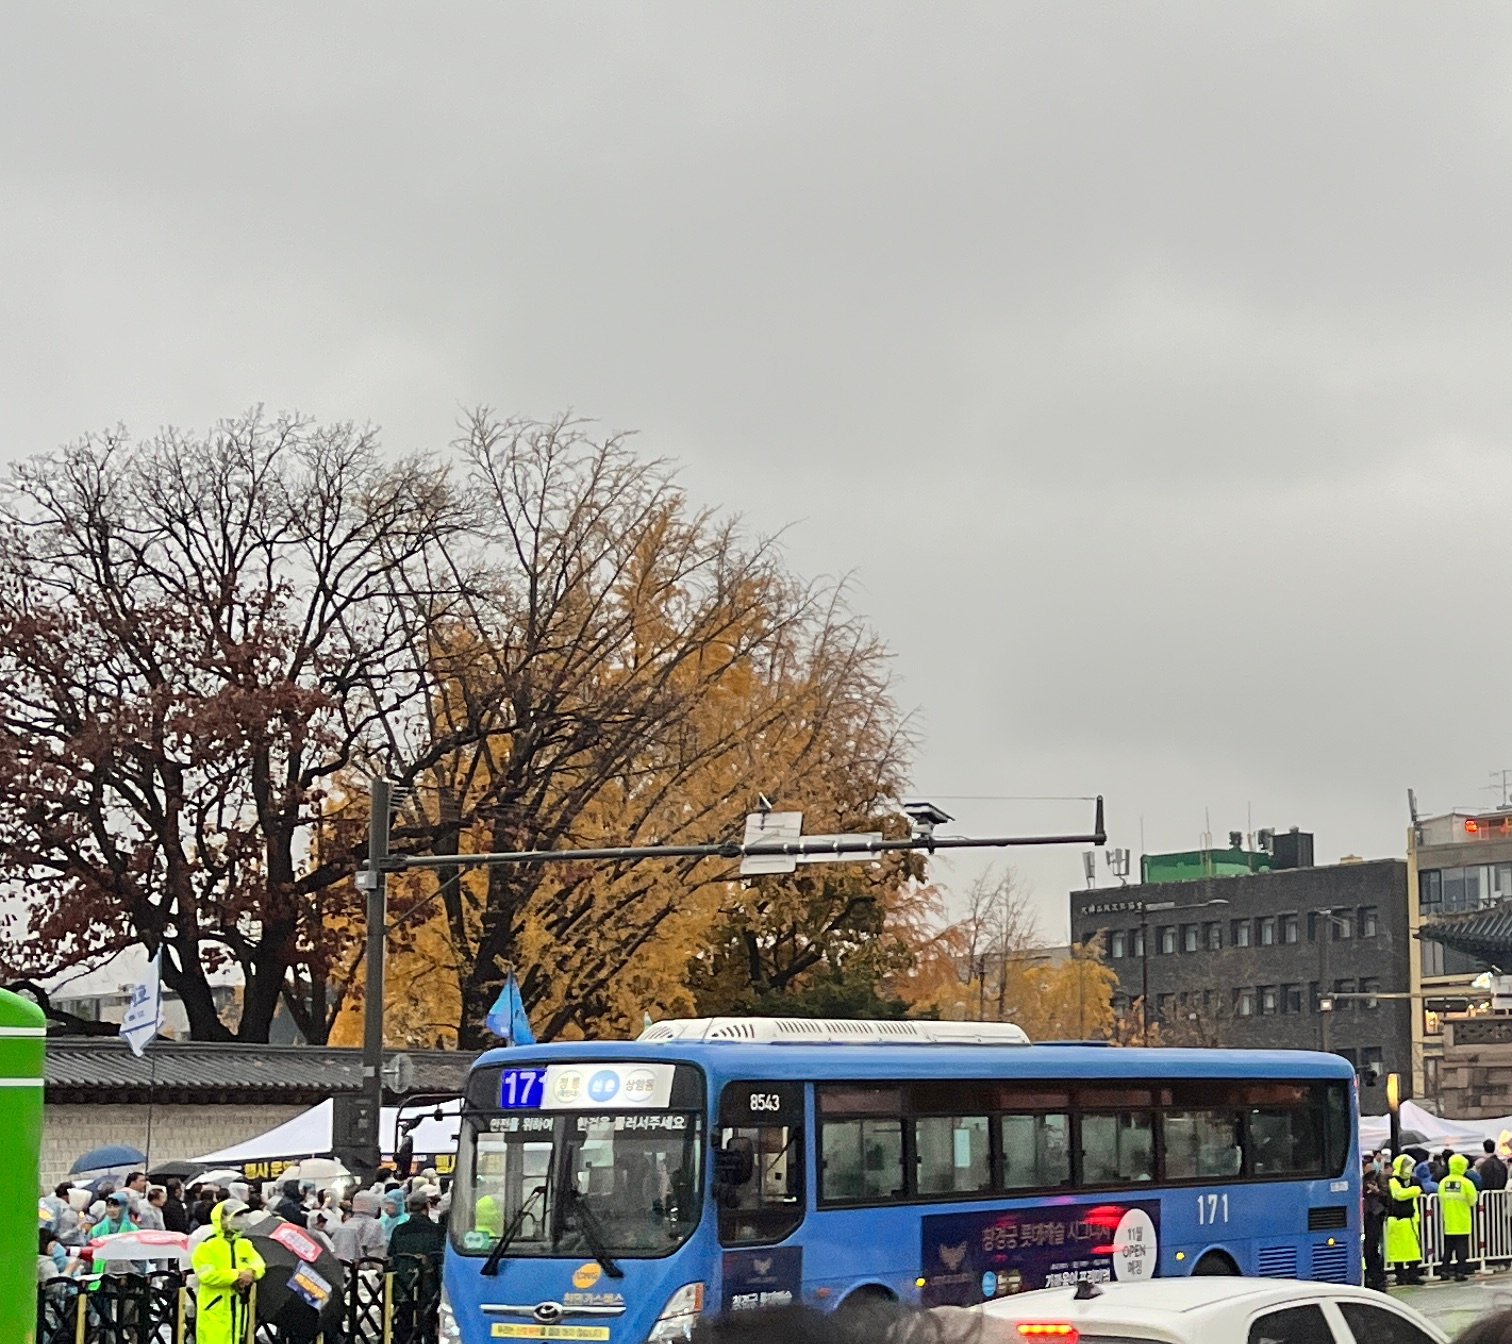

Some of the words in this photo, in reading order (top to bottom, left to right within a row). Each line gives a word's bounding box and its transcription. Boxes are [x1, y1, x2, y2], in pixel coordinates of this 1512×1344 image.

[504, 1071, 548, 1105] 17
[750, 1093, 780, 1111] 8543
[1197, 1193, 1229, 1225] 171
[1122, 1245, 1146, 1258] OPEN
